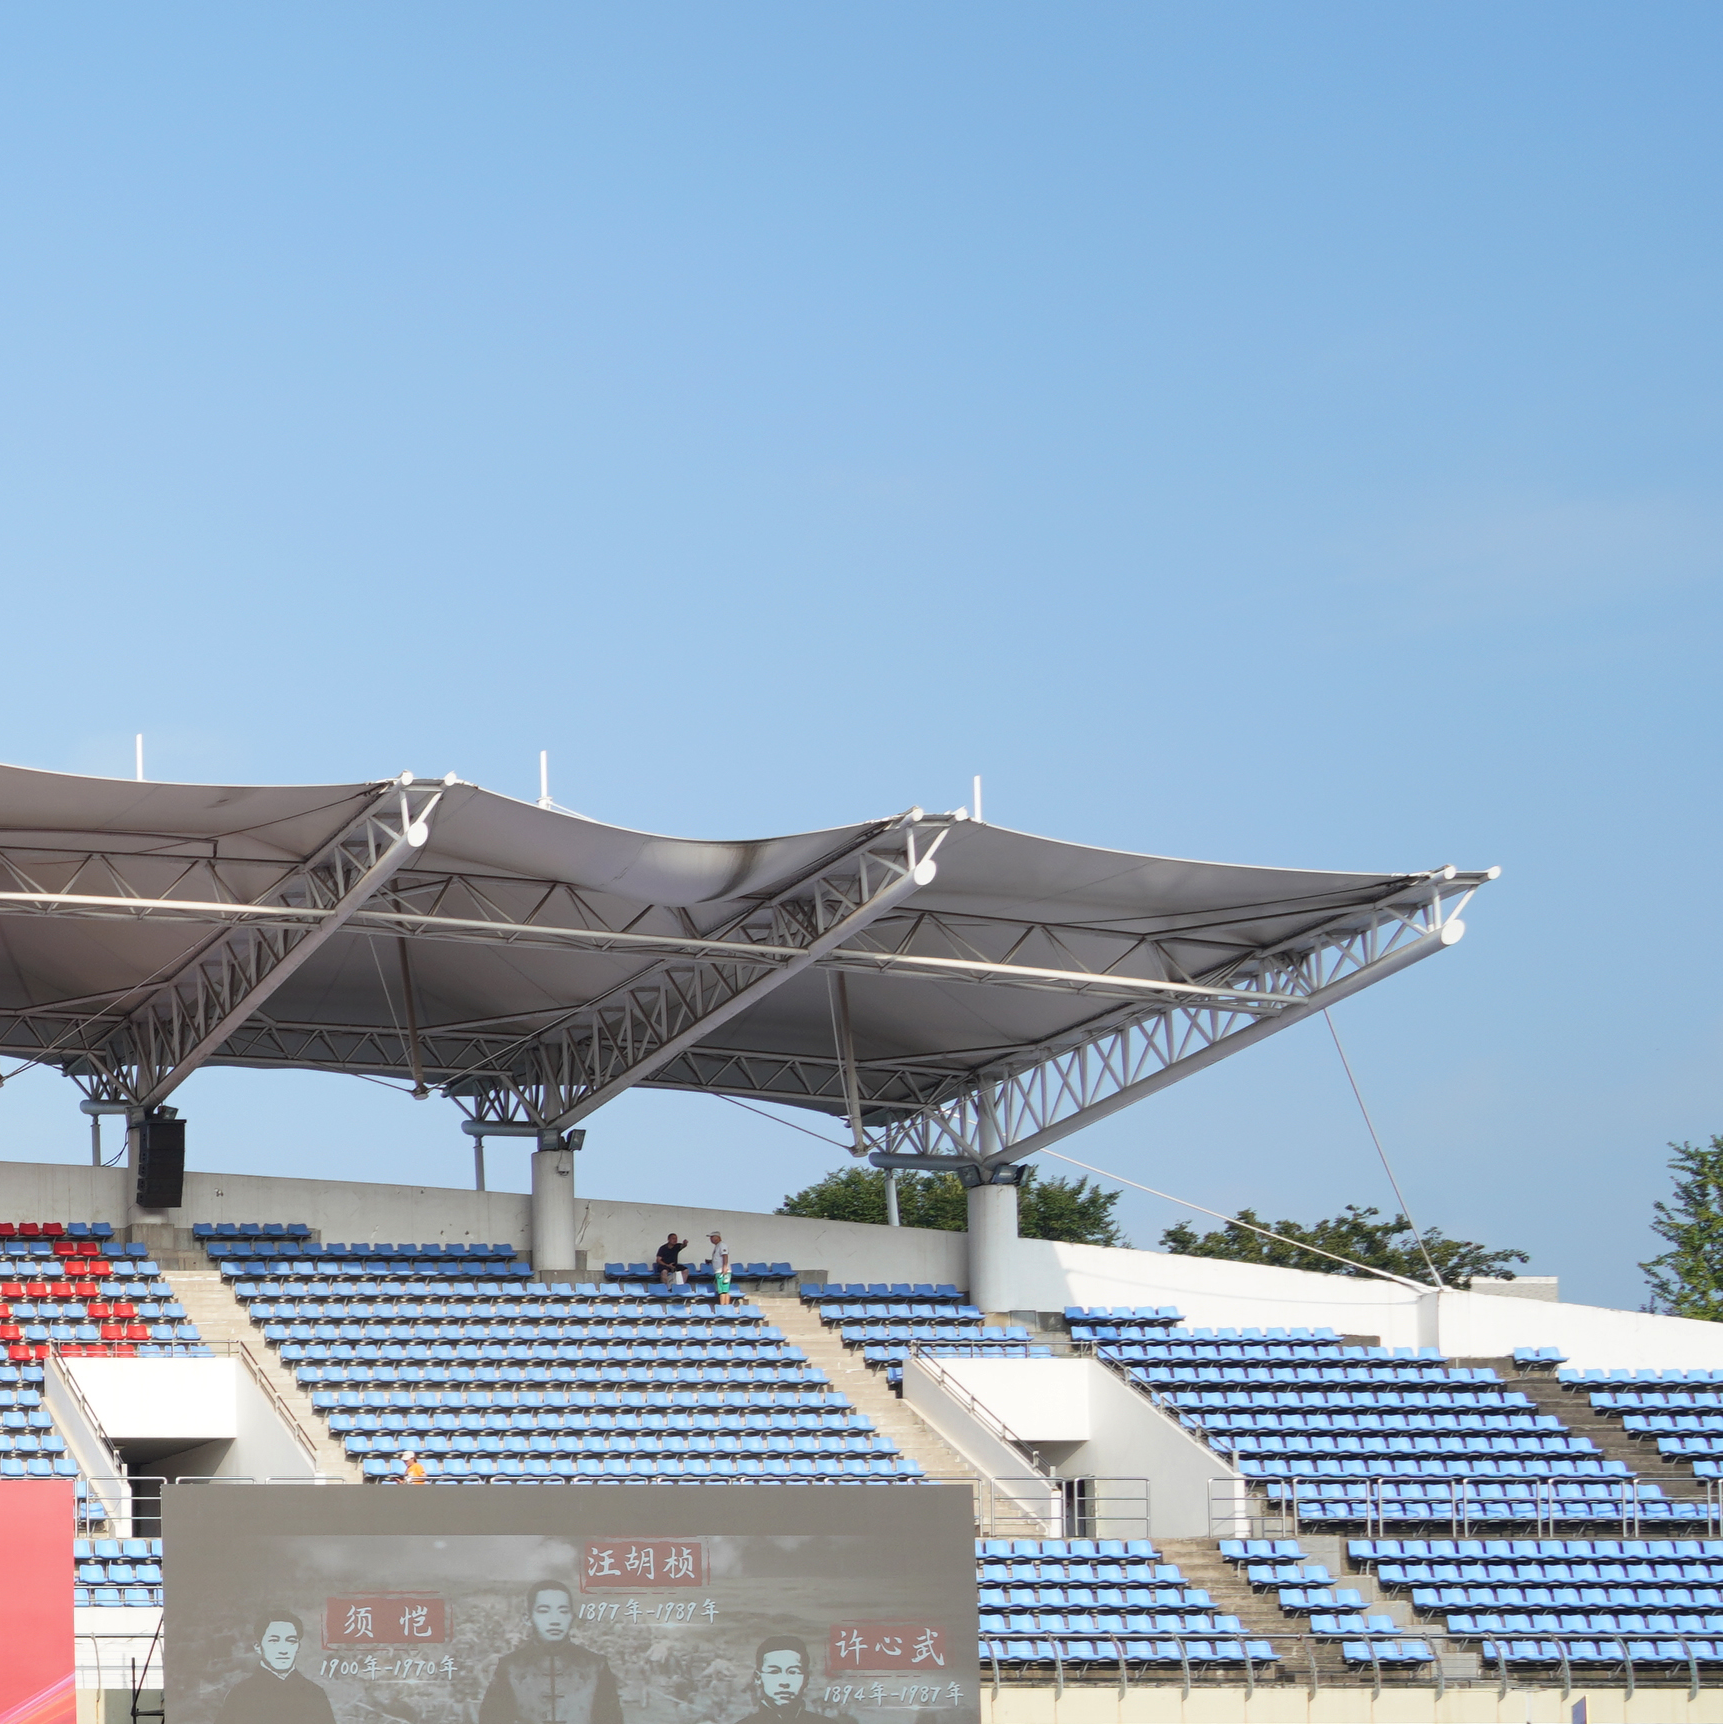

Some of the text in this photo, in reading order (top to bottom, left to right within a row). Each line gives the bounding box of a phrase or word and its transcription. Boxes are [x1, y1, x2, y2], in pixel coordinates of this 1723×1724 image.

[587, 1545, 696, 1580] 汪胡桢
[343, 1604, 433, 1639] 须恺
[578, 1598, 720, 1626] 1897年-1989年
[835, 1628, 946, 1667] 许心武
[320, 1655, 458, 1682] 1900年-1970年
[824, 1681, 964, 1708] 1894年-1987年
